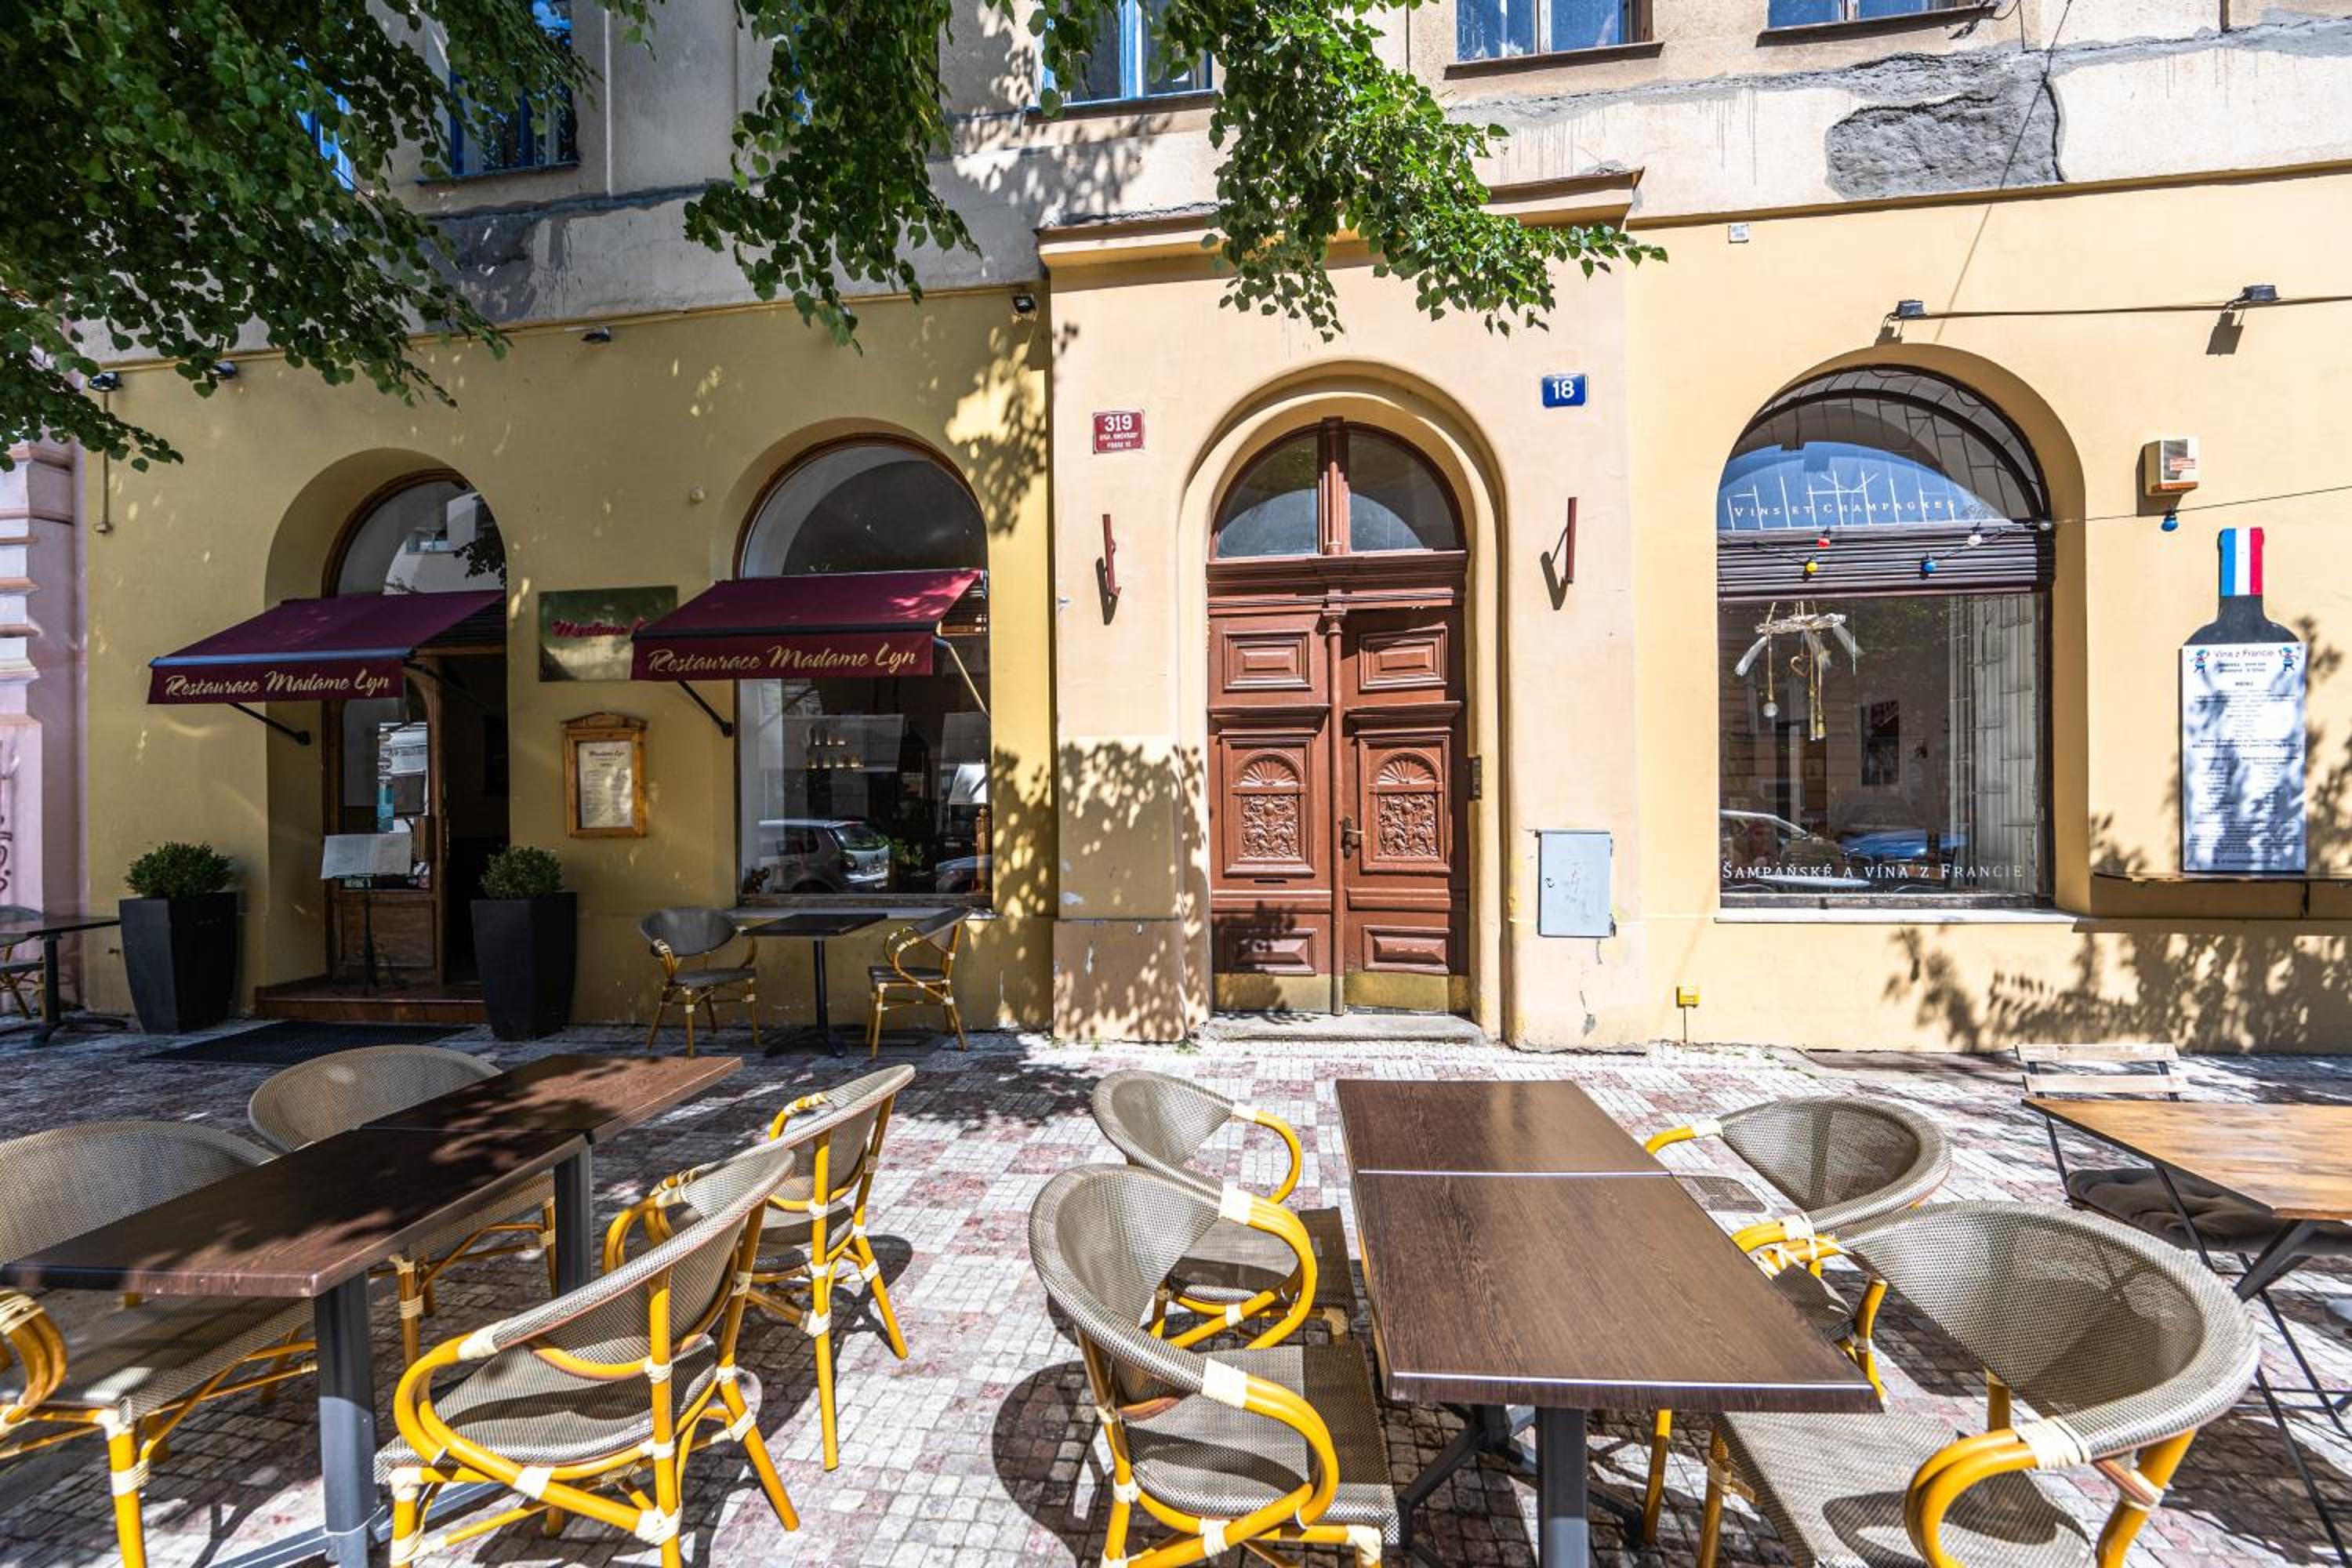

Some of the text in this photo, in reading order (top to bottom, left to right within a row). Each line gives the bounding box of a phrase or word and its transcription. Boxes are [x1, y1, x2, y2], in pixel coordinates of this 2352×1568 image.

[1552, 380, 1575, 399] 18
[1104, 415, 1133, 432] 319
[1734, 506, 1781, 517] VINS
[648, 641, 917, 674] Restaurace Madame Lyn
[165, 668, 390, 697] Restaurace Madame Lyn
[1843, 866, 1854, 879] A
[1864, 863, 1910, 880] VÍNA
[1920, 866, 1930, 879] Z
[1940, 864, 2024, 880] FRANCIE
